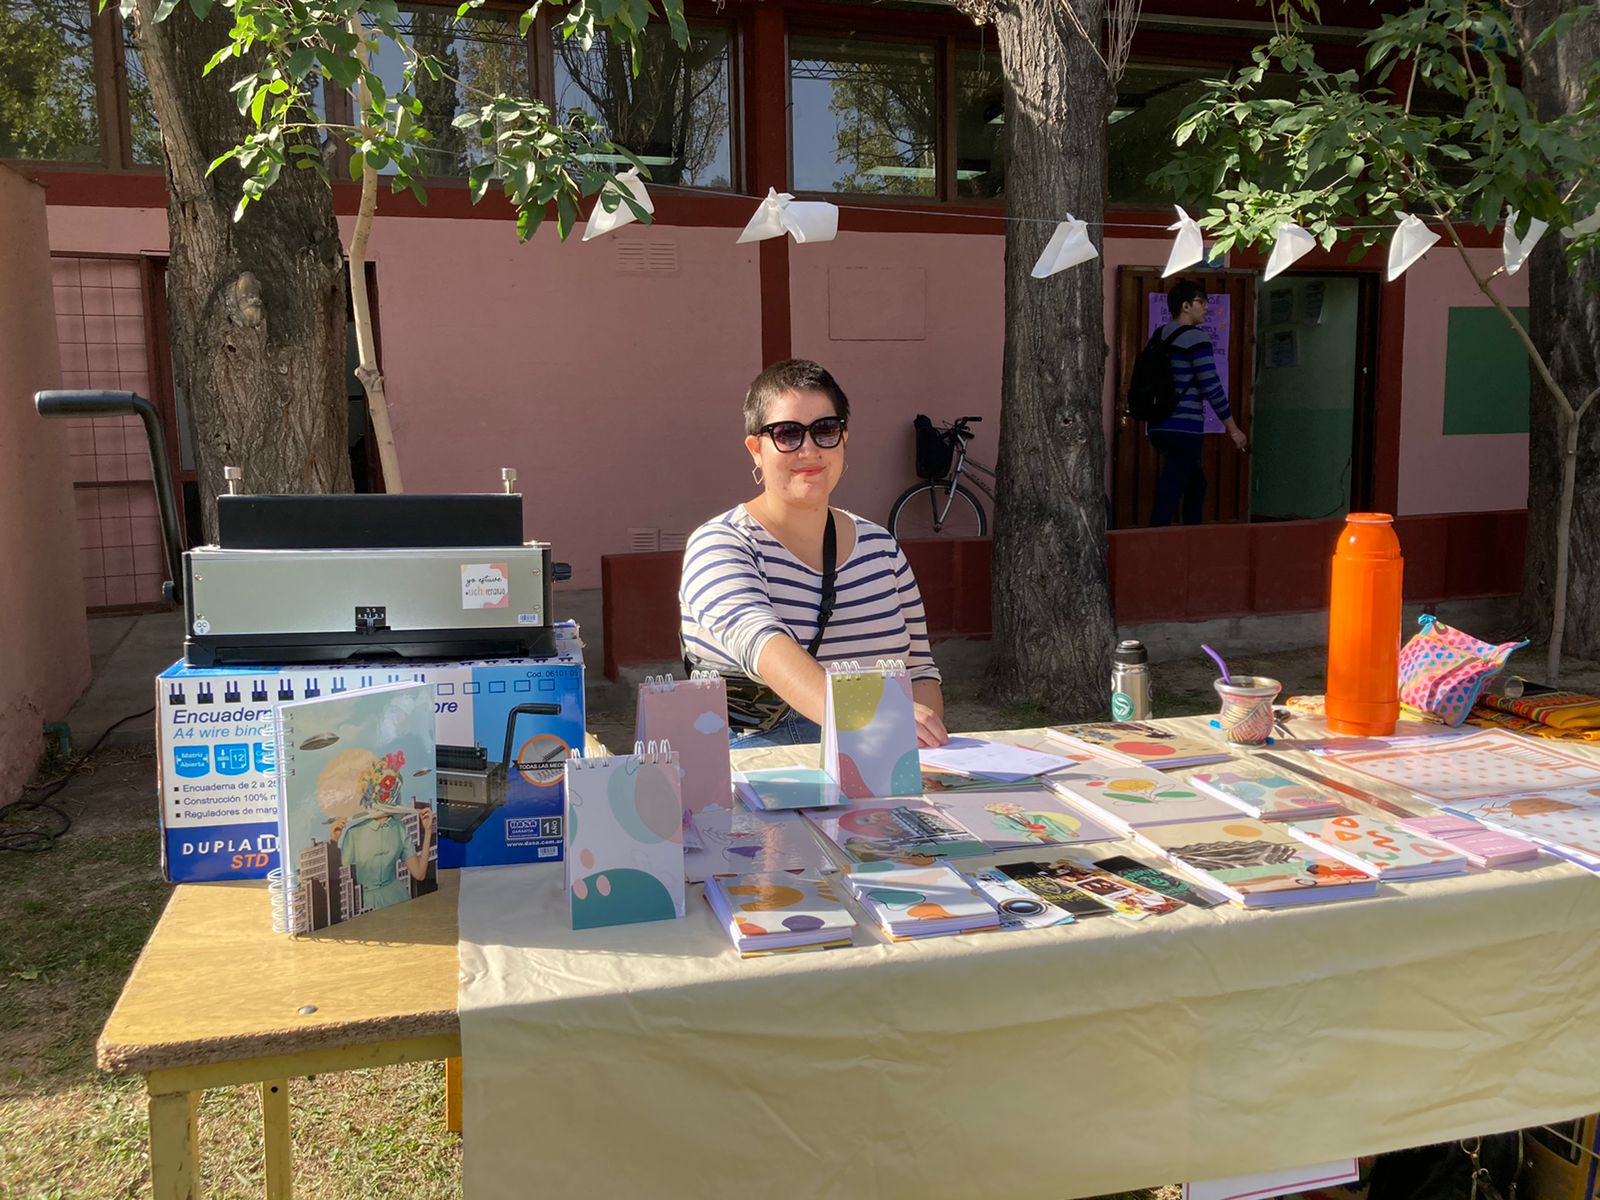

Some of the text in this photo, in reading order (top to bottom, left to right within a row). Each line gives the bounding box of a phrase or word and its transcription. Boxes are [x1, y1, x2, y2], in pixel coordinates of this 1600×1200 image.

[173, 727, 194, 740] A4
[199, 725, 230, 738] wire
[180, 760, 205, 768] Abierta
[232, 753, 244, 762] 12
[182, 783, 236, 793] Encuaderna
[238, 781, 249, 790] de
[251, 780, 258, 789] 2
[259, 781, 265, 789] a
[183, 795, 241, 806] Construcción
[243, 793, 268, 802] 100%
[184, 807, 240, 819] Reguladores
[242, 807, 254, 815] de
[543, 821, 550, 834] 1
[182, 838, 252, 856] DUPLA
[230, 852, 270, 870] STD
